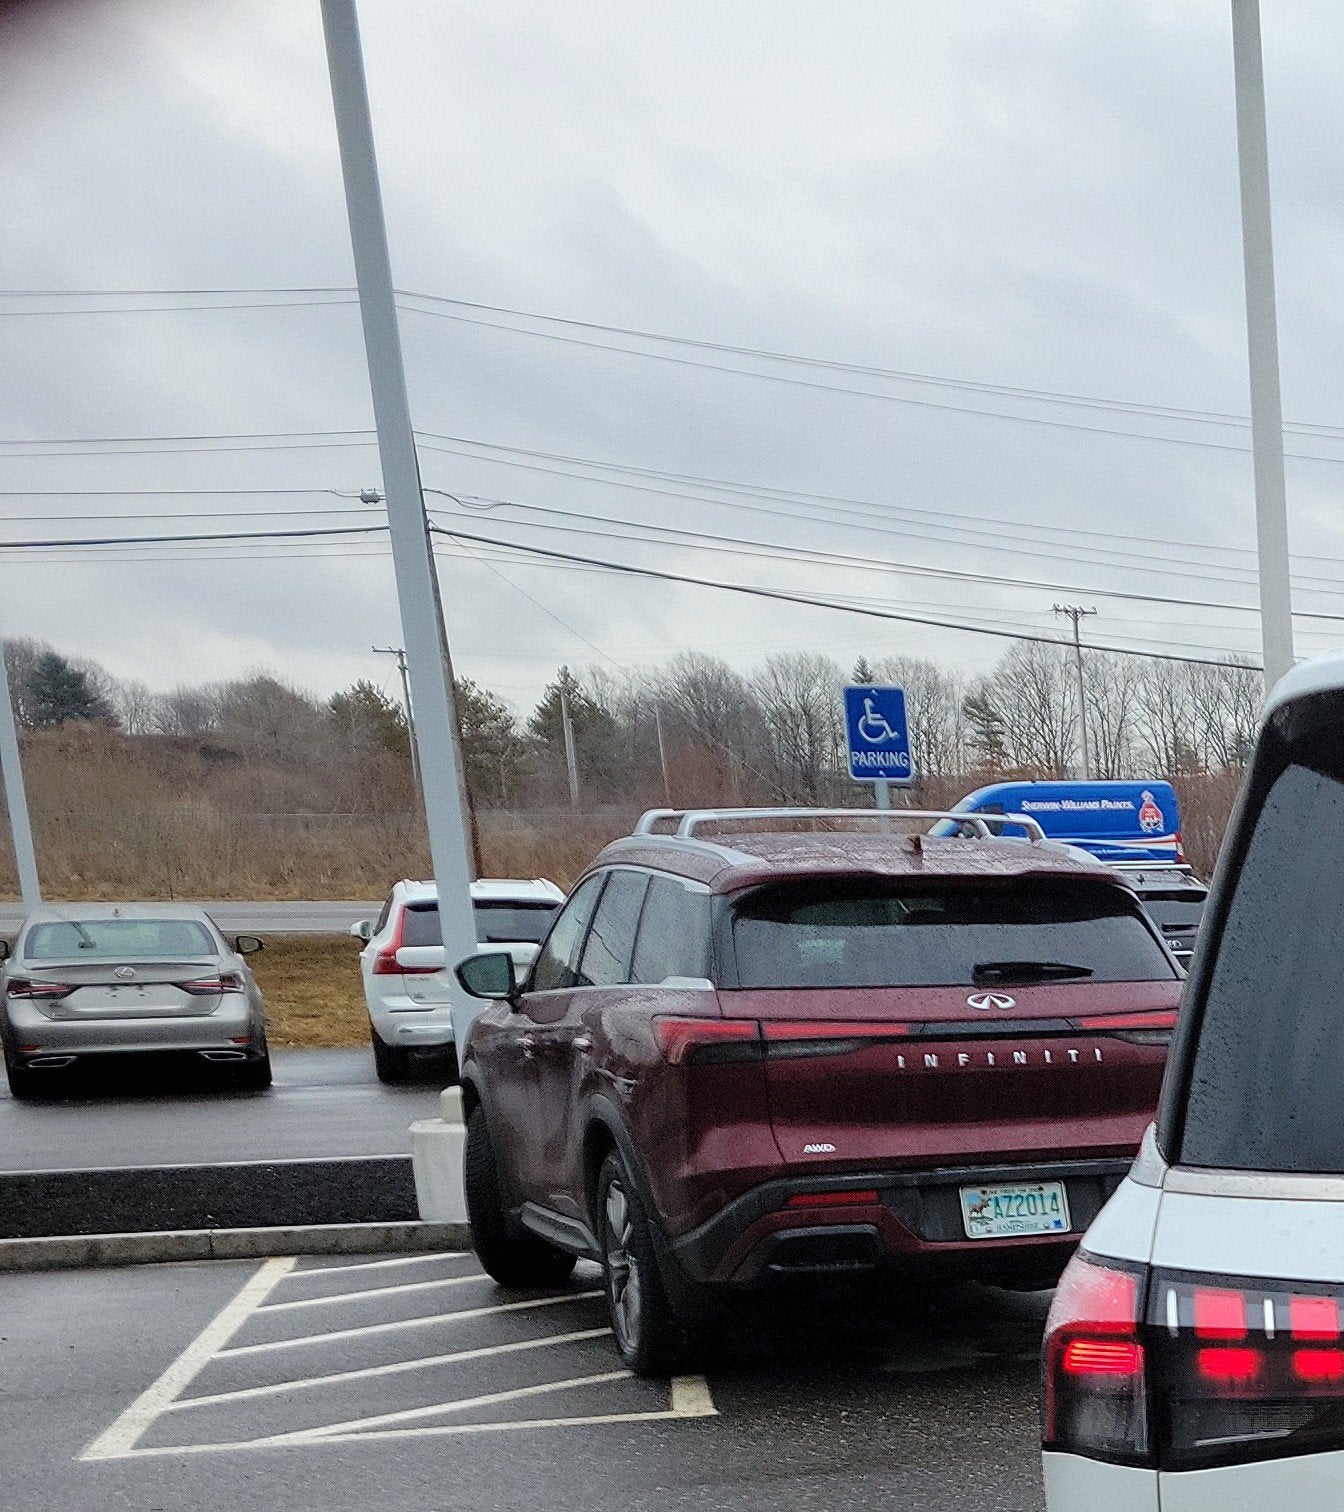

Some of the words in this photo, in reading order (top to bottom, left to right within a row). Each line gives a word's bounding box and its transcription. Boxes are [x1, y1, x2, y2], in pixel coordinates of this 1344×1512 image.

[851, 751, 909, 768] PARKING
[898, 1048, 1102, 1069] INFINITI
[804, 1143, 836, 1153] AWD
[992, 1191, 1060, 1219] AZ2014
